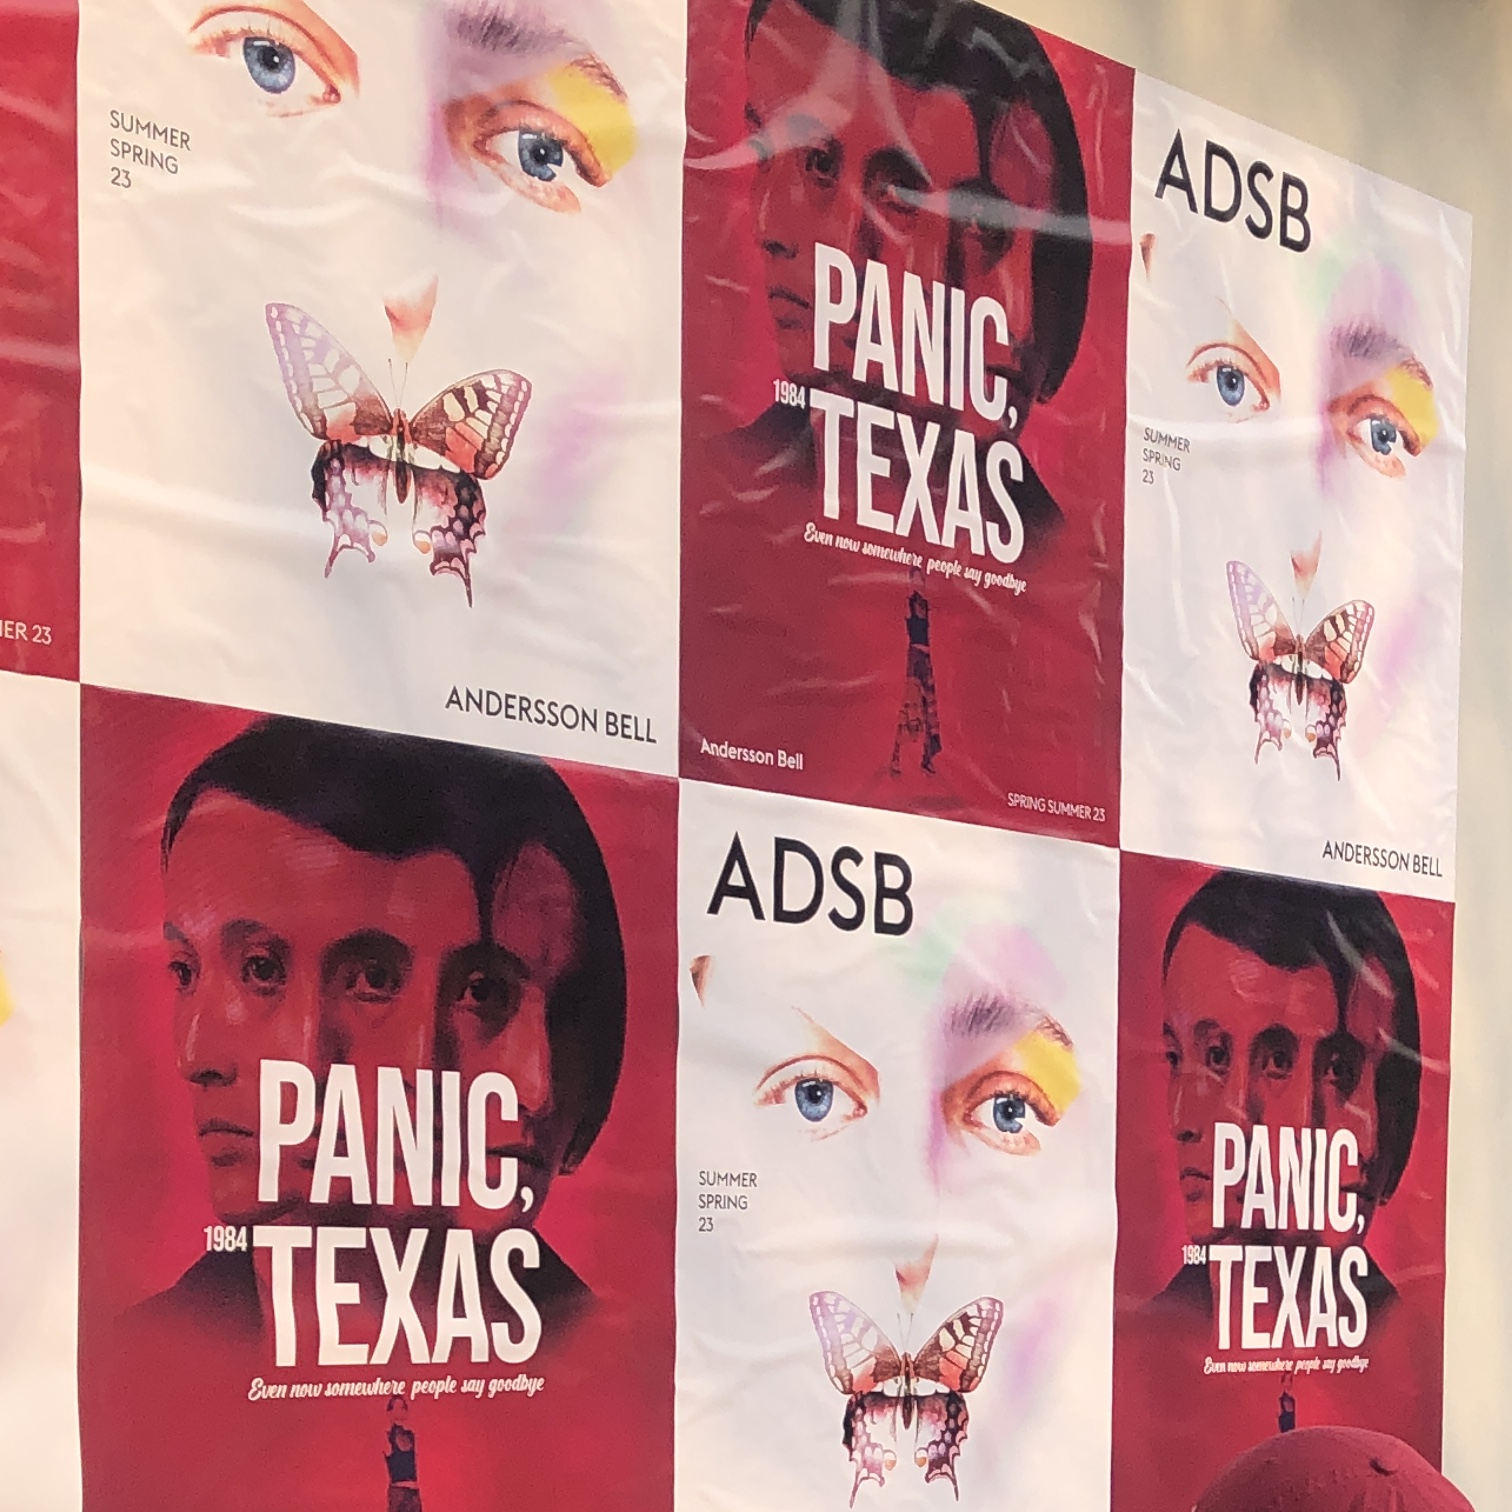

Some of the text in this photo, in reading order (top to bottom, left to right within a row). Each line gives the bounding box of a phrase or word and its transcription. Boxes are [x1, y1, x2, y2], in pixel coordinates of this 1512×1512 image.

[109, 109, 191, 151] SUMMER
[110, 138, 179, 174] SPRING
[110, 166, 132, 189] 23
[1154, 127, 1312, 253] ADSB
[813, 241, 1018, 429] PANIC,
[772, 378, 806, 409] 1984
[1143, 427, 1191, 453] SUMMER
[809, 387, 1025, 564] TEXAS
[1142, 468, 1154, 485] 23
[803, 521, 1027, 596] Even now somewhere people say goodbye
[32, 624, 53, 645] 23
[445, 685, 657, 744] ANDERSSON BELL
[700, 737, 804, 771] Andersson Bell
[1007, 792, 1106, 822] SPRING SUMMER 23
[1322, 840, 1443, 877] ANDERSSON BELL
[706, 830, 914, 936] ADSB
[257, 1058, 535, 1213] PANIC,
[698, 1170, 758, 1188] SUMMER
[1212, 1121, 1365, 1235] PANIC,
[697, 1193, 748, 1210] SPRING
[203, 1225, 248, 1252] 1984
[698, 1216, 714, 1232] 23
[1181, 1244, 1207, 1265] 1984
[252, 1225, 542, 1367] TEXAS
[1208, 1244, 1369, 1350] TEXAS
[248, 1374, 545, 1401] Even now somewhere people say goodbye
